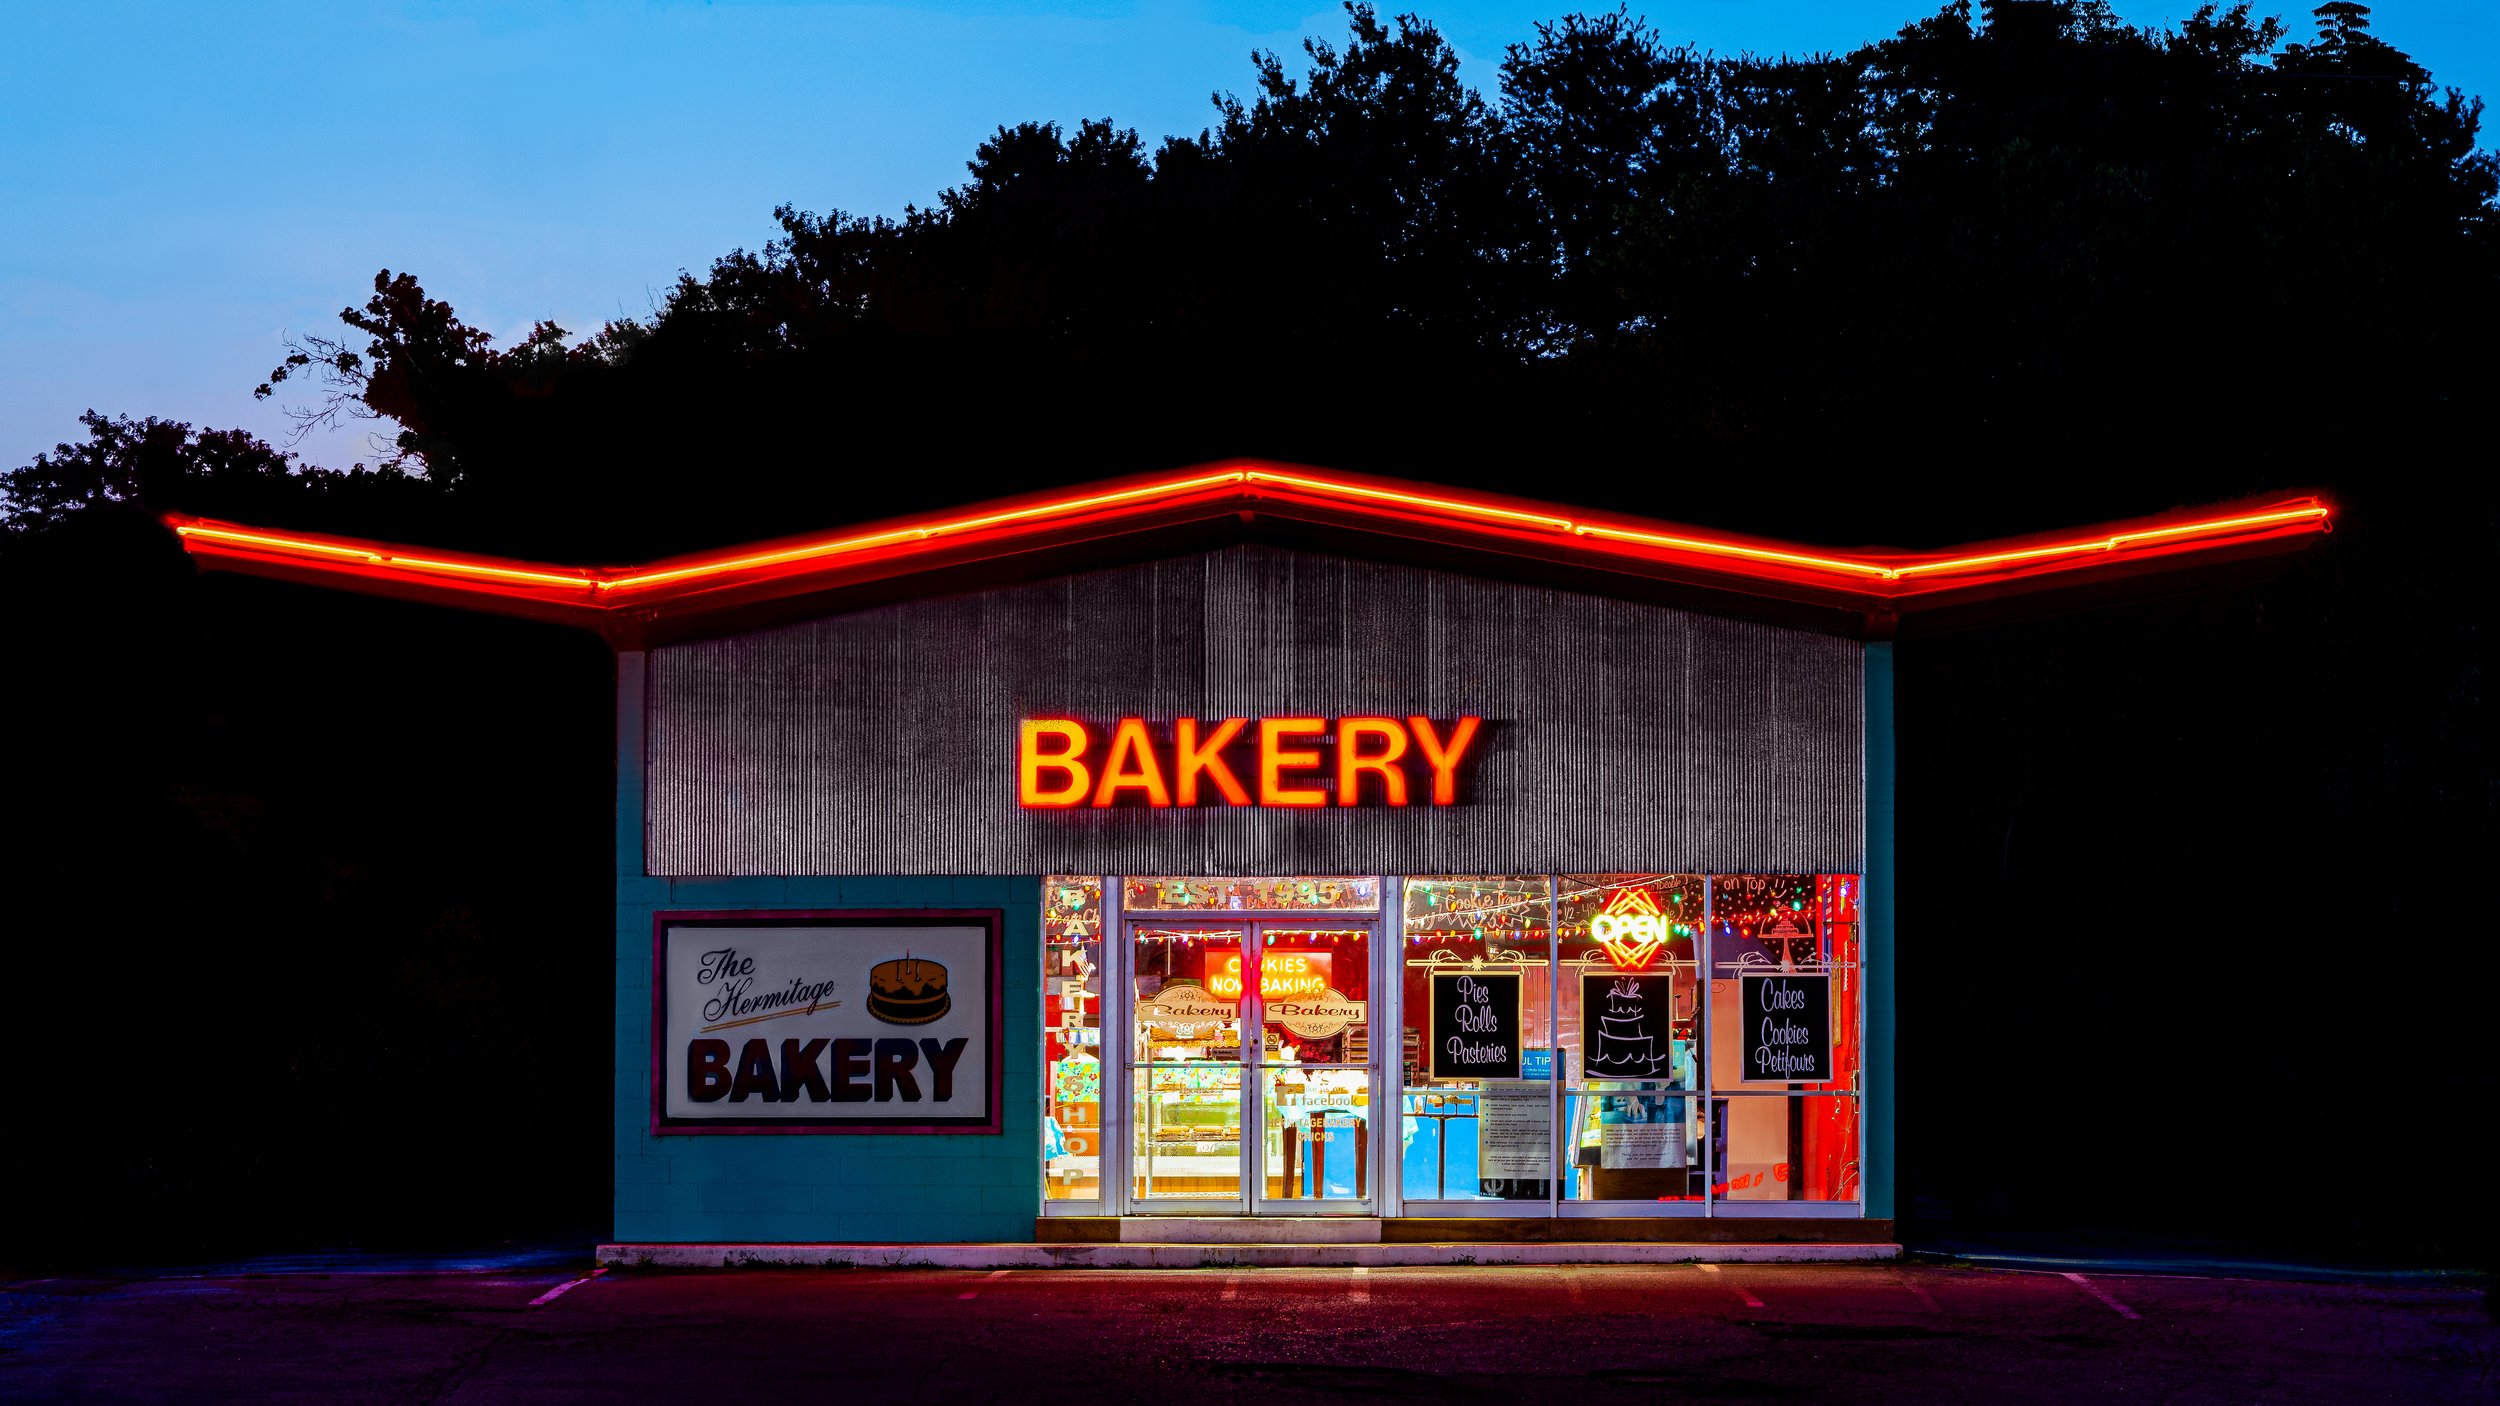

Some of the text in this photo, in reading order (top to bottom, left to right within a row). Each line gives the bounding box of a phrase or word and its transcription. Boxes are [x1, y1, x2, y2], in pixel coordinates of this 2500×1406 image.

[1019, 716, 1482, 808] BAKERY
[1164, 880, 1232, 904] EST
[1252, 880, 1341, 904] 1995
[1592, 914, 1668, 943] OPEN
[696, 947, 756, 985] The
[1228, 957, 1307, 973] CKIES
[703, 977, 835, 1023] Hermitage
[1456, 975, 1489, 1004] Pies
[1761, 977, 1805, 1012] Cakes
[1141, 1003, 1233, 1019] Bakery
[1269, 1003, 1360, 1019] Bakery
[1454, 1004, 1498, 1033] Rolls
[1761, 1016, 1809, 1047] Cookies
[1446, 1035, 1507, 1064] Pasteries
[1754, 1045, 1815, 1080] Petifours
[687, 1037, 970, 1104] BAKERY
[1301, 1094, 1359, 1106] facebook
[1063, 1075, 1088, 1186] SHOP
[1297, 1131, 1335, 1142] CHICKS
